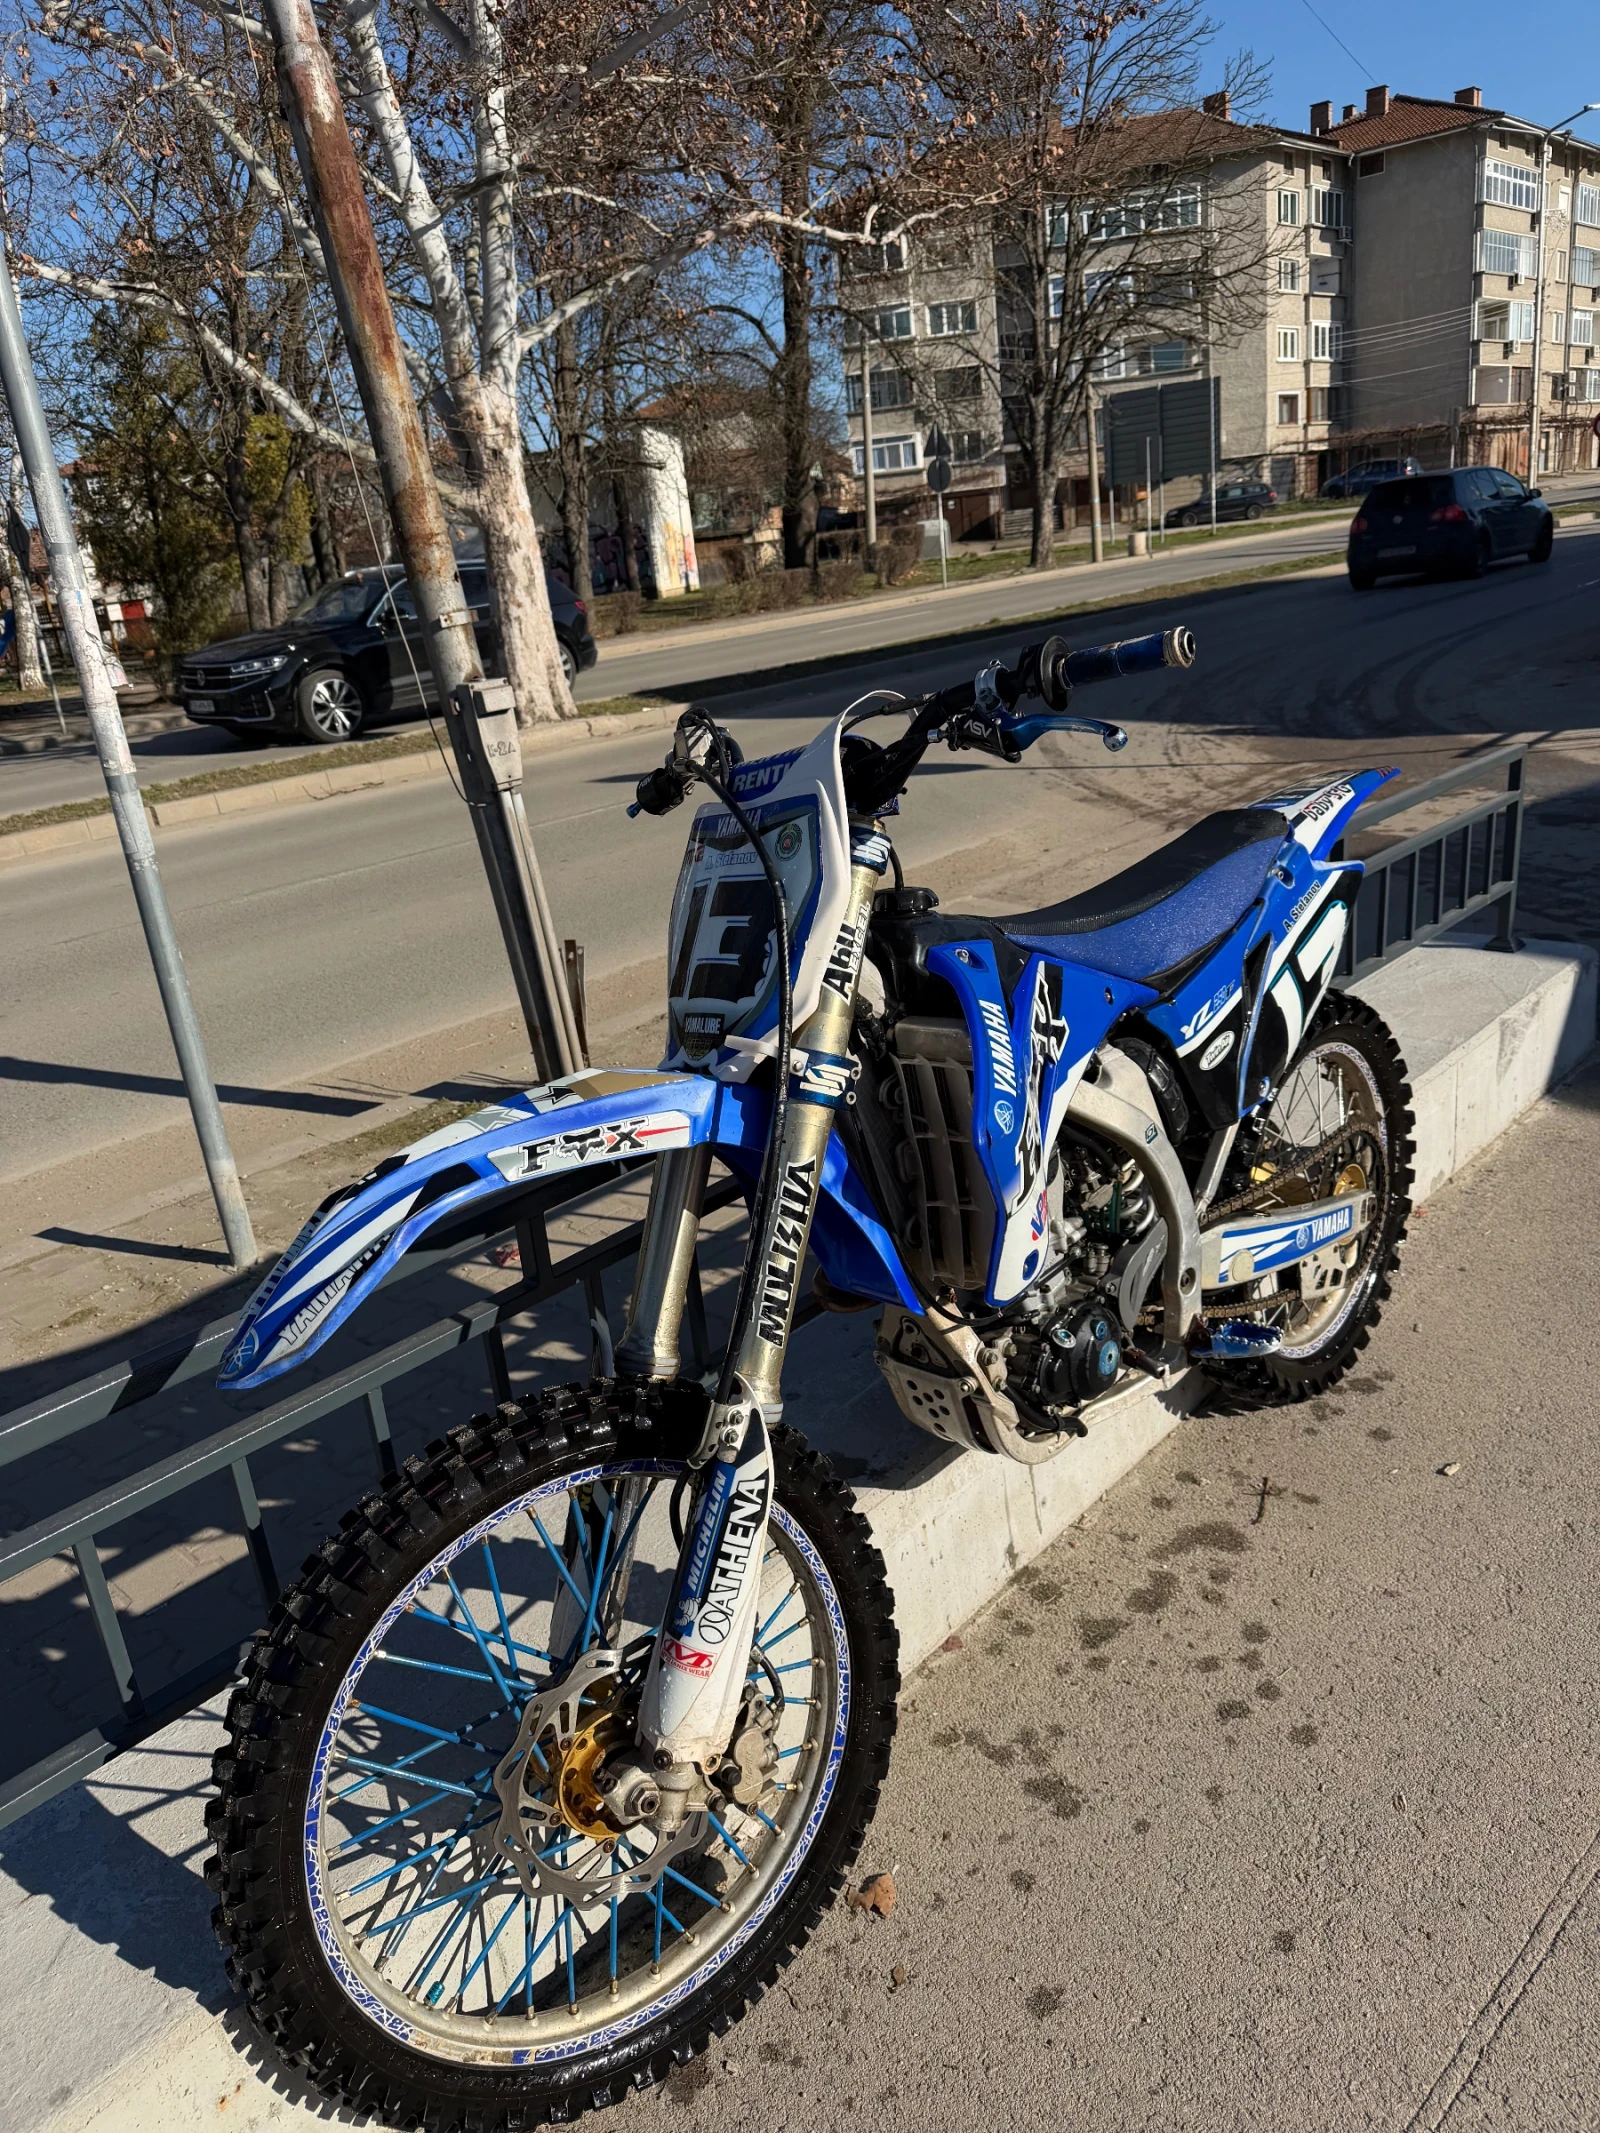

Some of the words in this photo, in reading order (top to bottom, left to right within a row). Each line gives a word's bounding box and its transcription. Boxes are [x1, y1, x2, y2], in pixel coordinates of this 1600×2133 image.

[963, 719, 993, 738] ASV
[1290, 880, 1322, 921] Stefanov
[685, 1016, 721, 1034] YAMALUBE
[978, 999, 1017, 1098] YAMAHA
[1311, 1207, 1350, 1243] YAMAHA
[687, 1469, 727, 1593] MICHELIN
[707, 1478, 766, 1617] ATHENA
[688, 1667, 711, 1678] WEAR
